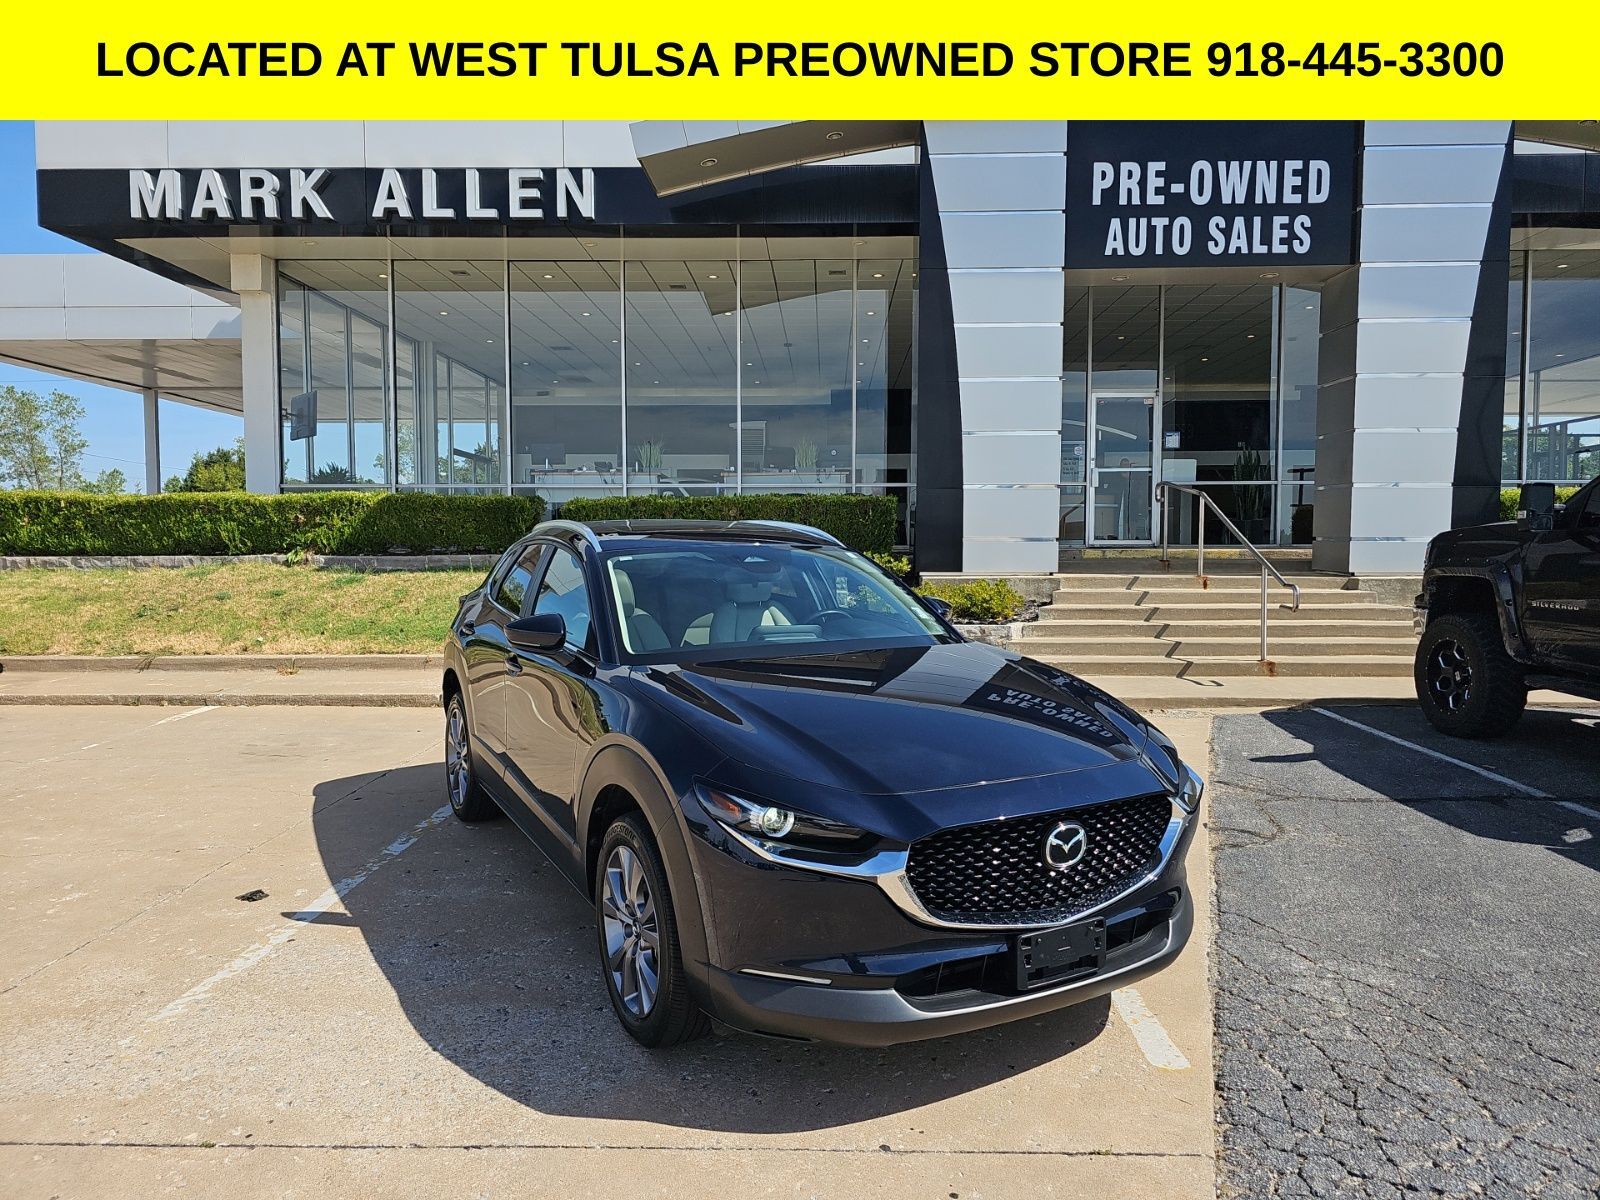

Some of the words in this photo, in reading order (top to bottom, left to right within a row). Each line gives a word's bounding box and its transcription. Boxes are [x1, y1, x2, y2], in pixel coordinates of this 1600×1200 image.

[128, 167, 336, 221] MARK
[371, 167, 596, 221] ALLEN
[1091, 159, 1331, 206] PRE-OWNED
[1104, 215, 1192, 256] AUTO
[1207, 214, 1312, 255] SALES
